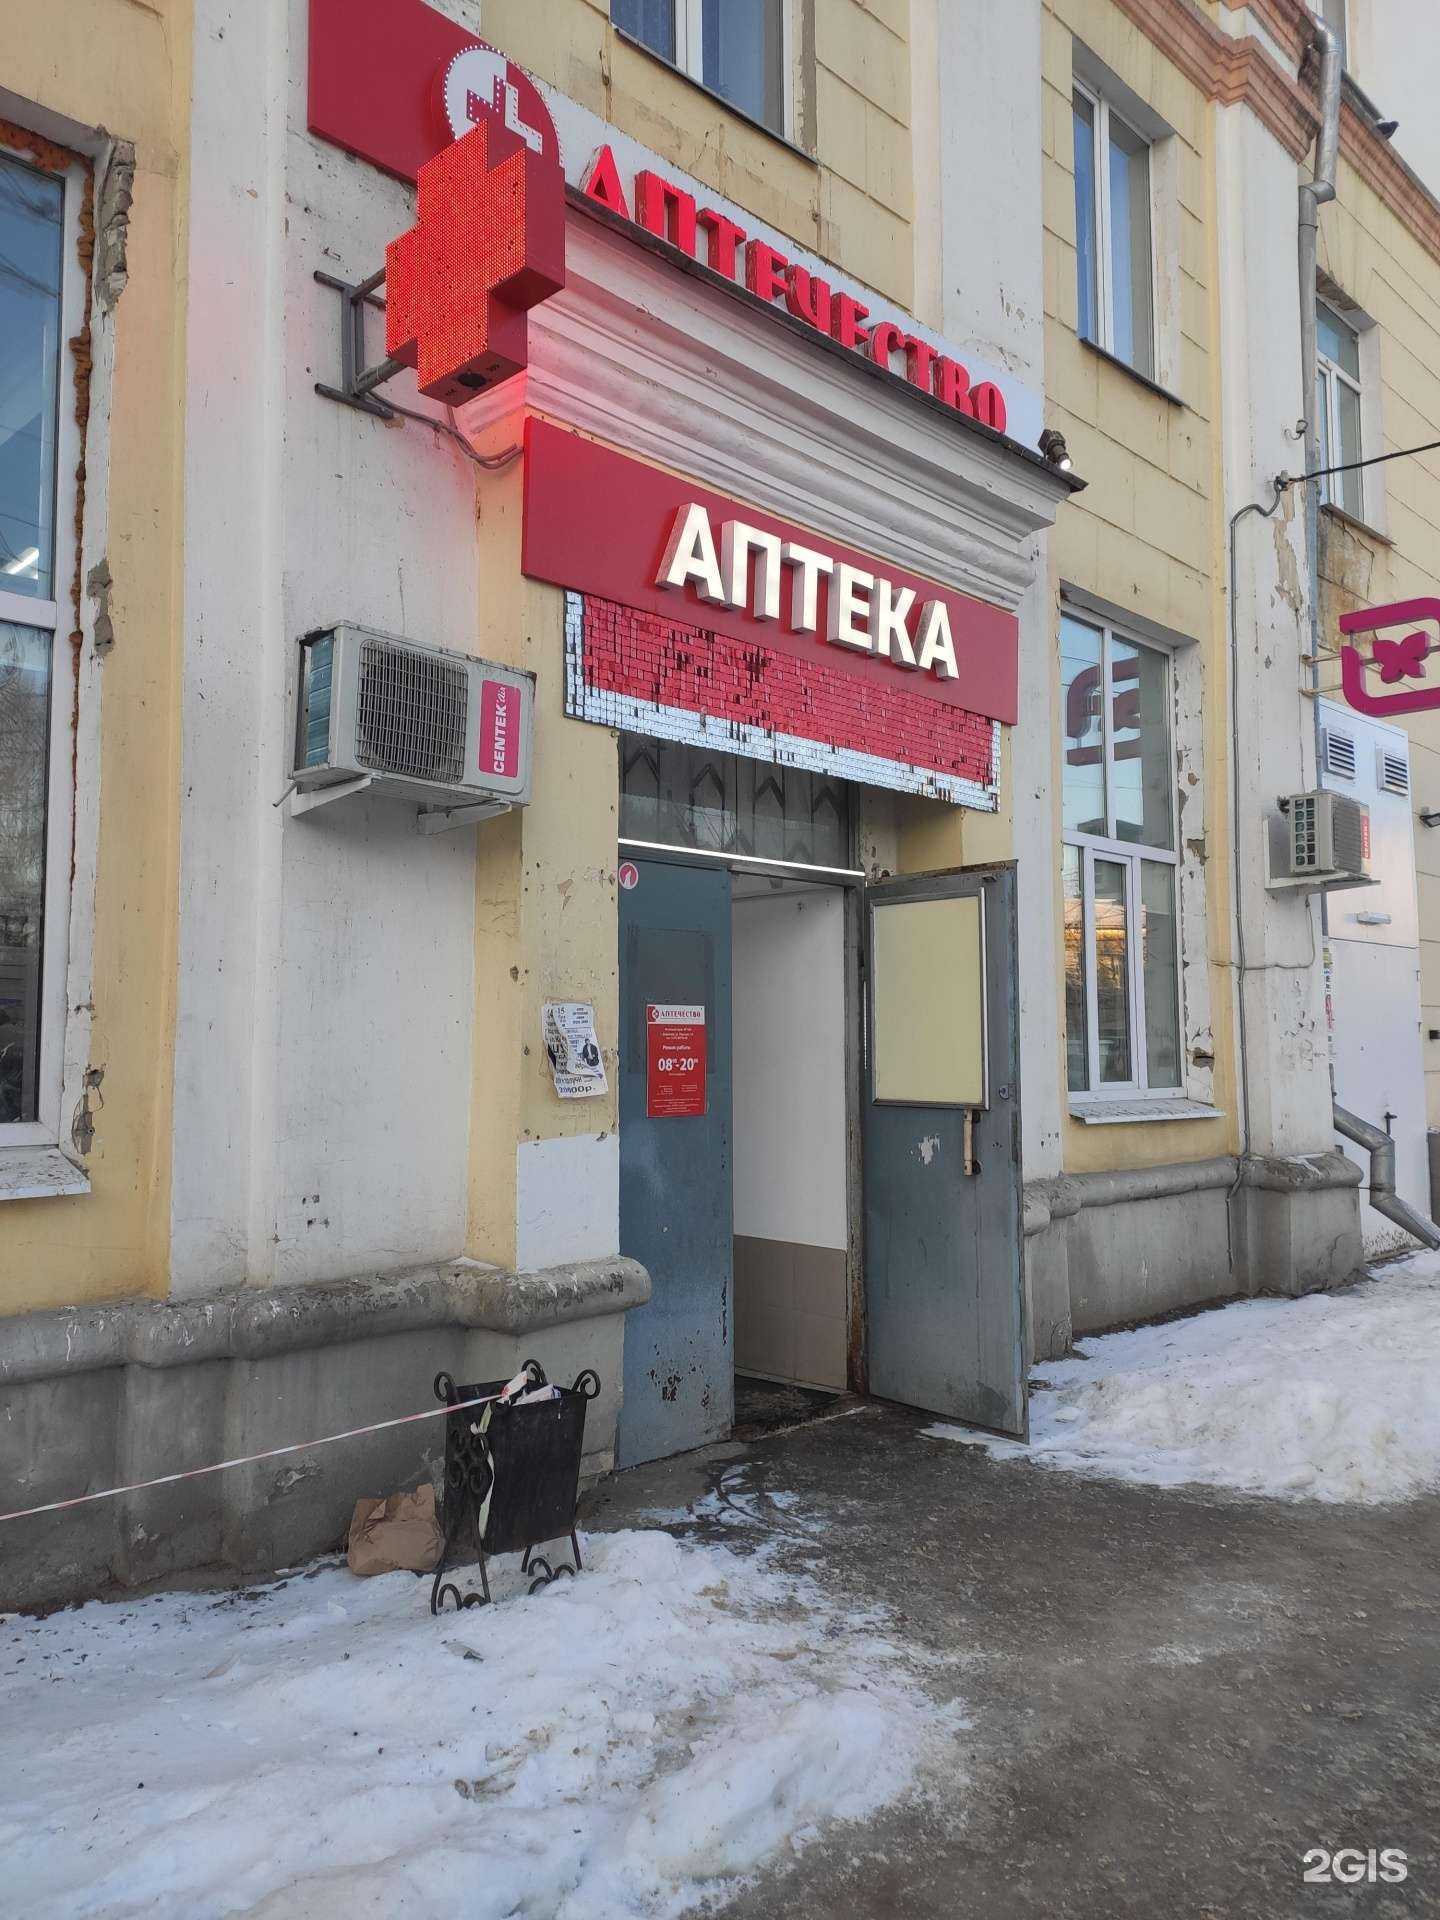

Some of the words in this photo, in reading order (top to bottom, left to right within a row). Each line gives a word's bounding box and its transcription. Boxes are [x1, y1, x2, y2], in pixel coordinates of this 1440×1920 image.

[577, 143, 1008, 434] АПТЕЧЕСТВО
[655, 502, 960, 681] АПТЕКА
[493, 701, 507, 774] CENTEK
[660, 1010, 701, 1018] АПТЕЧЕСТВО
